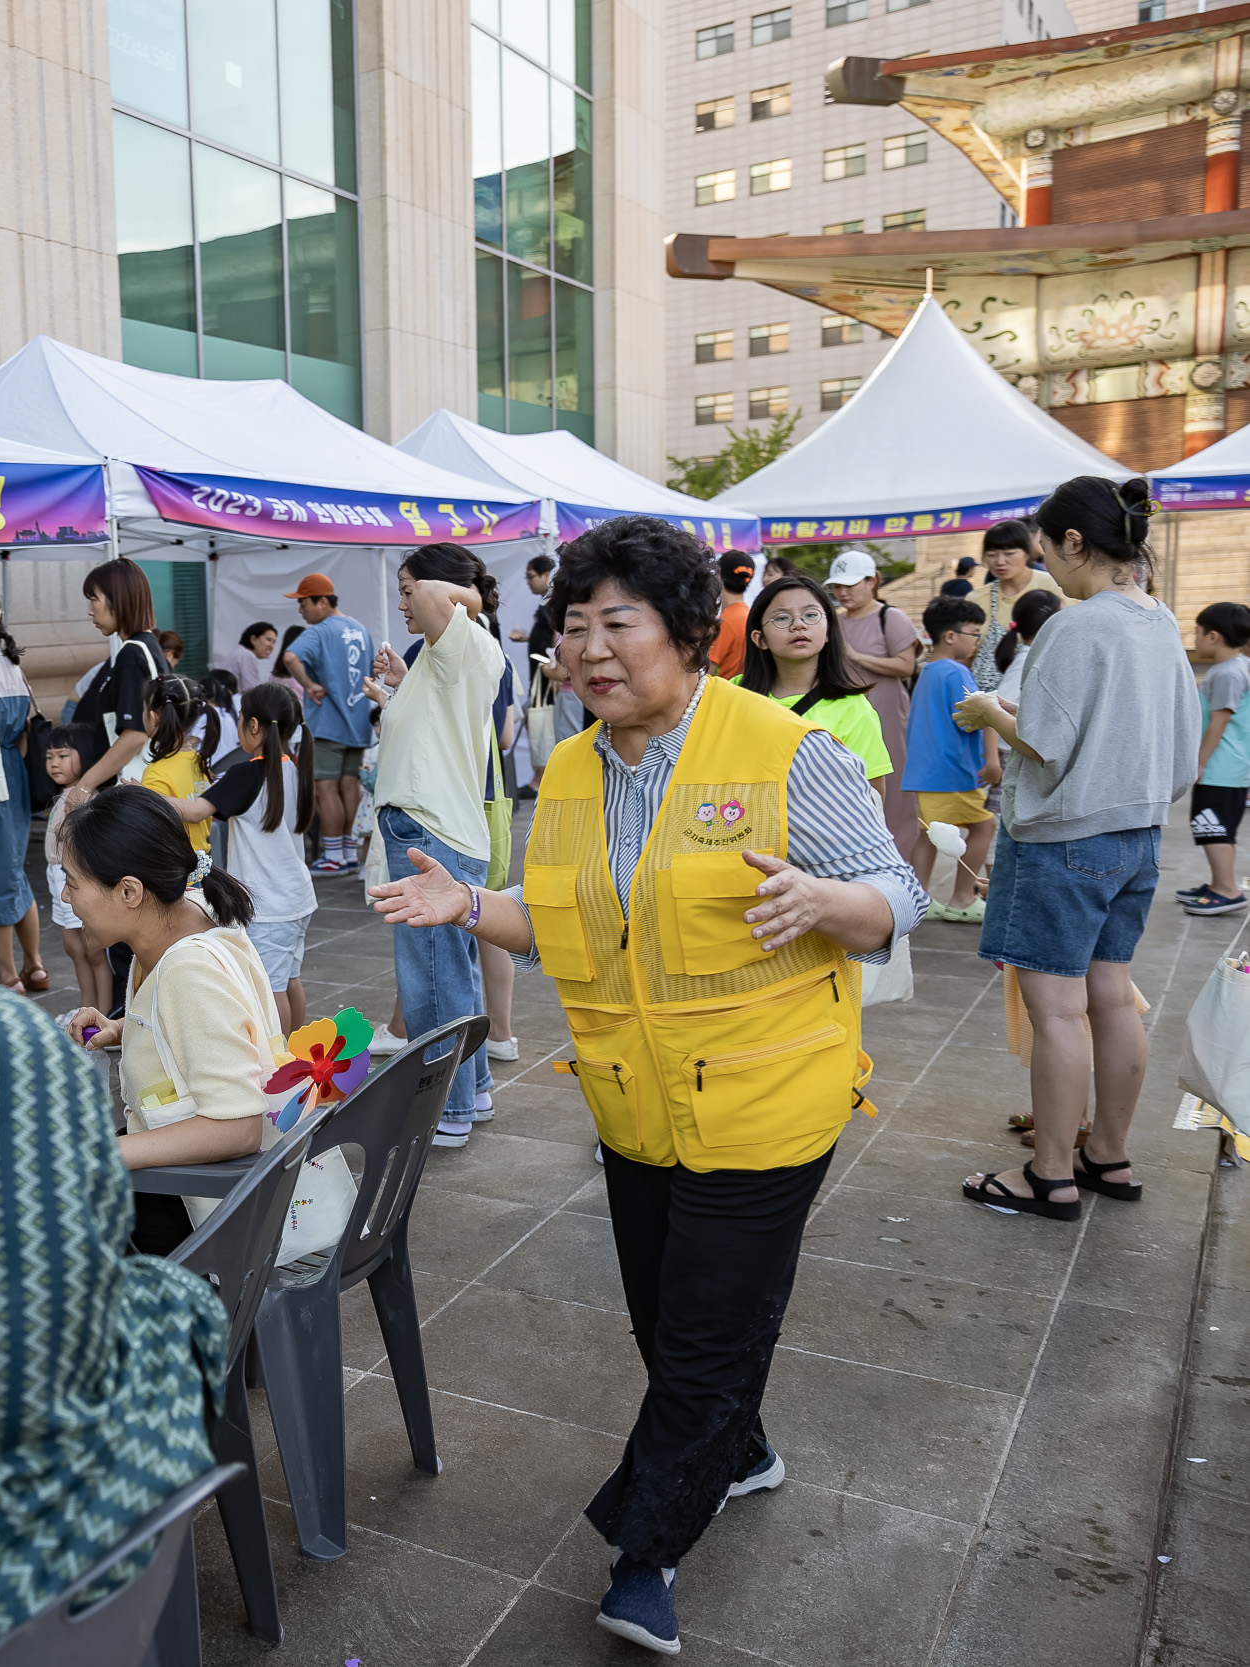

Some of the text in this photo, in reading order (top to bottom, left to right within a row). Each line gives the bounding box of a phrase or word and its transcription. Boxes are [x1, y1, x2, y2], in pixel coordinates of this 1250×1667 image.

[191, 485, 263, 518] 2023
[264, 496, 309, 523] 군자
[770, 518, 871, 539] 바람개비
[883, 511, 962, 534] 만들기
[682, 826, 753, 846] 군자축제추진위원회
